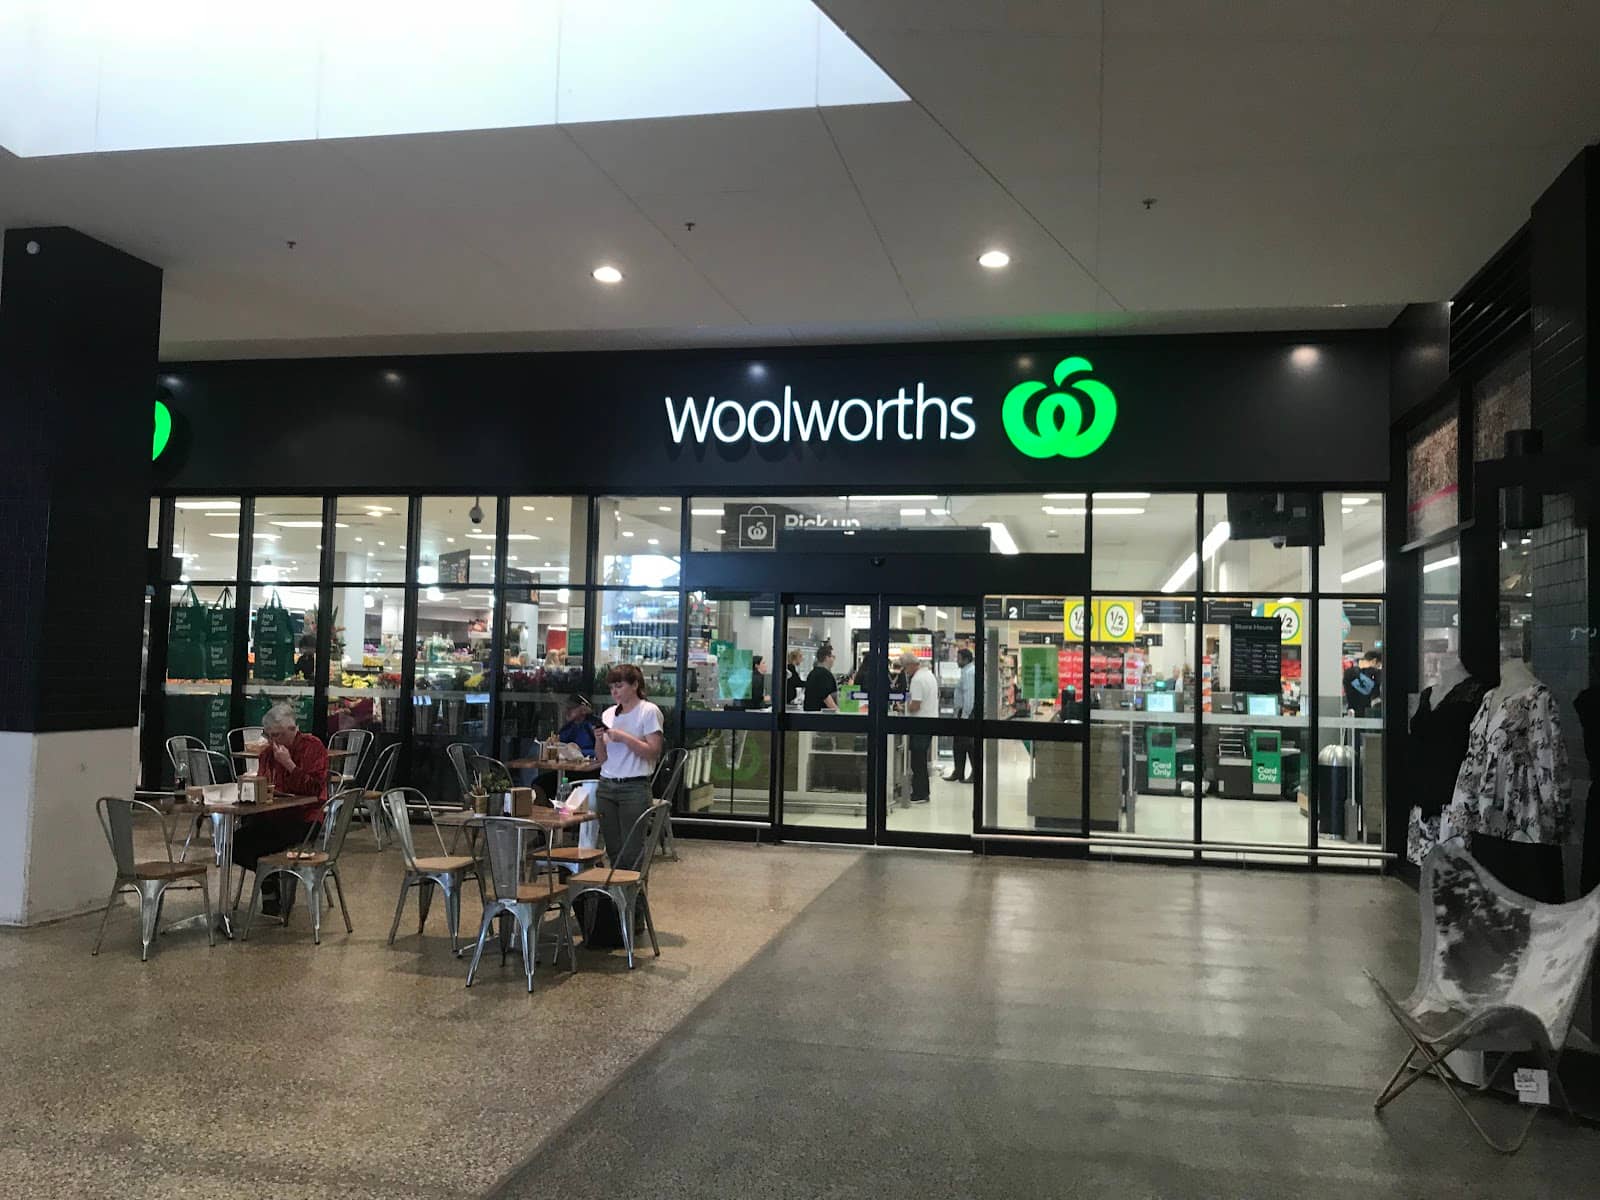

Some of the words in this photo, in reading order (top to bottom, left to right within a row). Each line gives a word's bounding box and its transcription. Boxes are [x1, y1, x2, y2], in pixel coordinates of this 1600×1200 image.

[664, 382, 977, 443] Woolworths
[794, 603, 801, 616] 1
[1008, 606, 1018, 619] 2
[1110, 610, 1124, 625] 1/2
[1152, 761, 1172, 769] Card
[1257, 766, 1277, 774] Card
[1153, 769, 1171, 777] Only
[1258, 774, 1277, 782] Only
